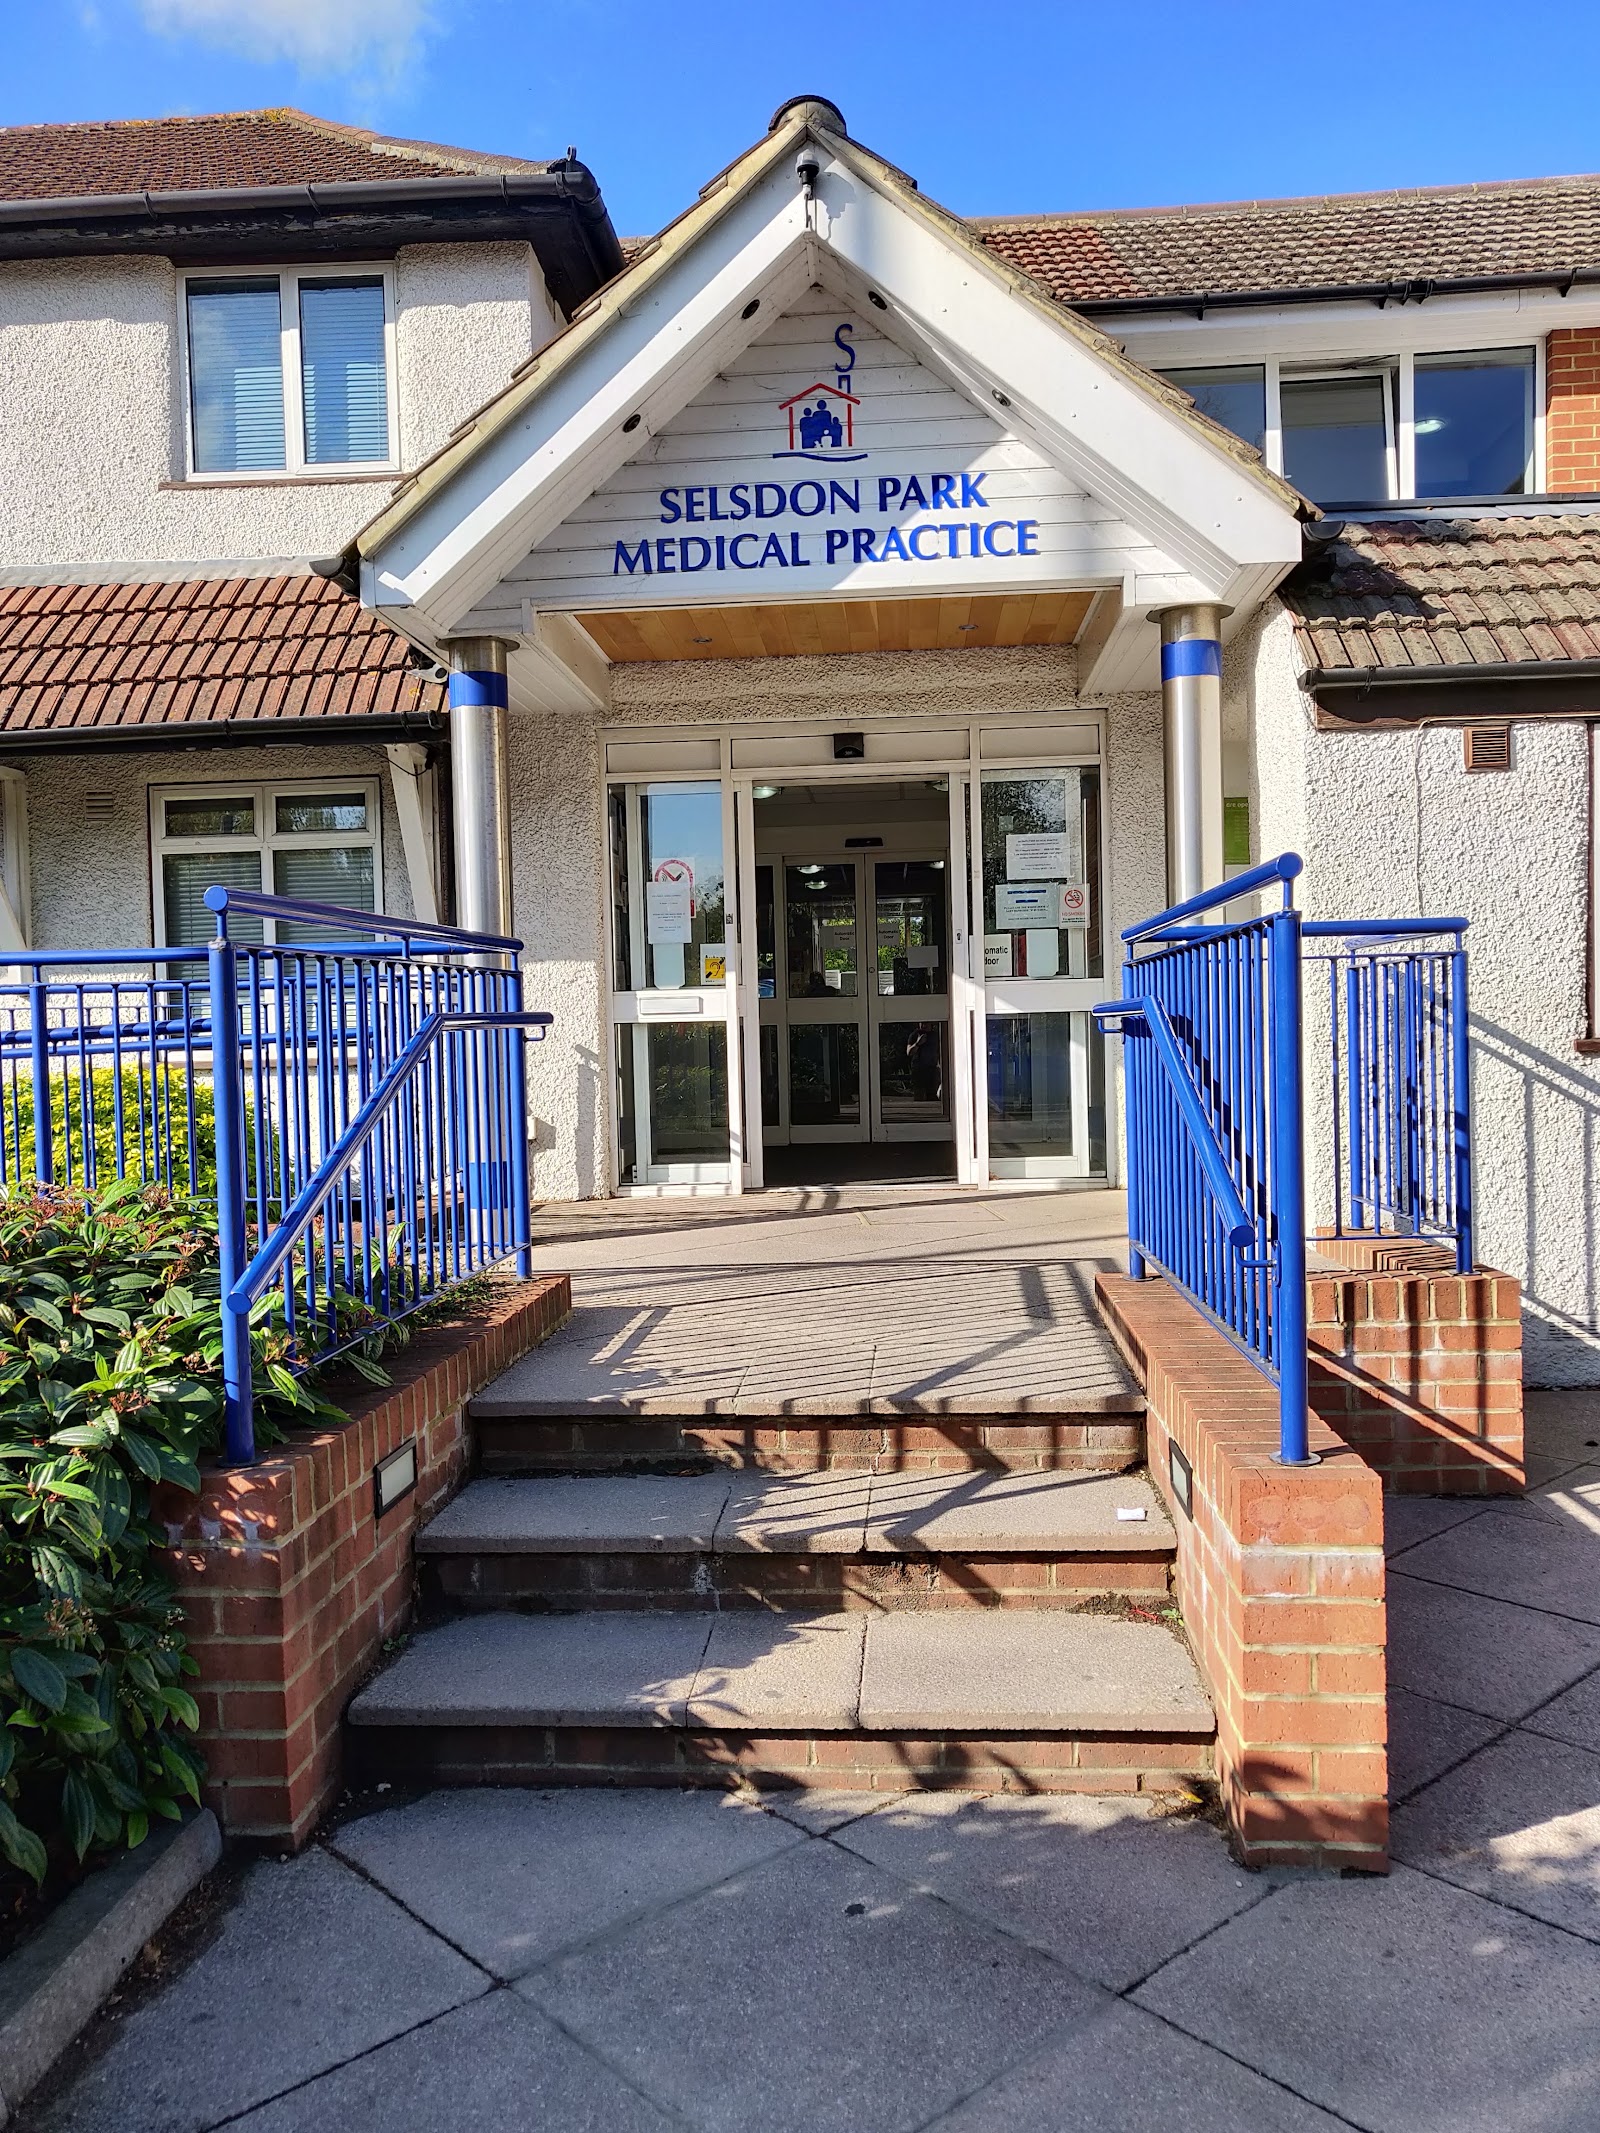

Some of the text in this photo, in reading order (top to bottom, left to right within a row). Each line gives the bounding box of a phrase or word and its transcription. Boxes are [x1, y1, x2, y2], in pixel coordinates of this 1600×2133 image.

[660, 472, 990, 524] SELSDON PARK
[613, 520, 1039, 574] MEDICAL PRACTICE
[985, 946, 1008, 955] omatic
